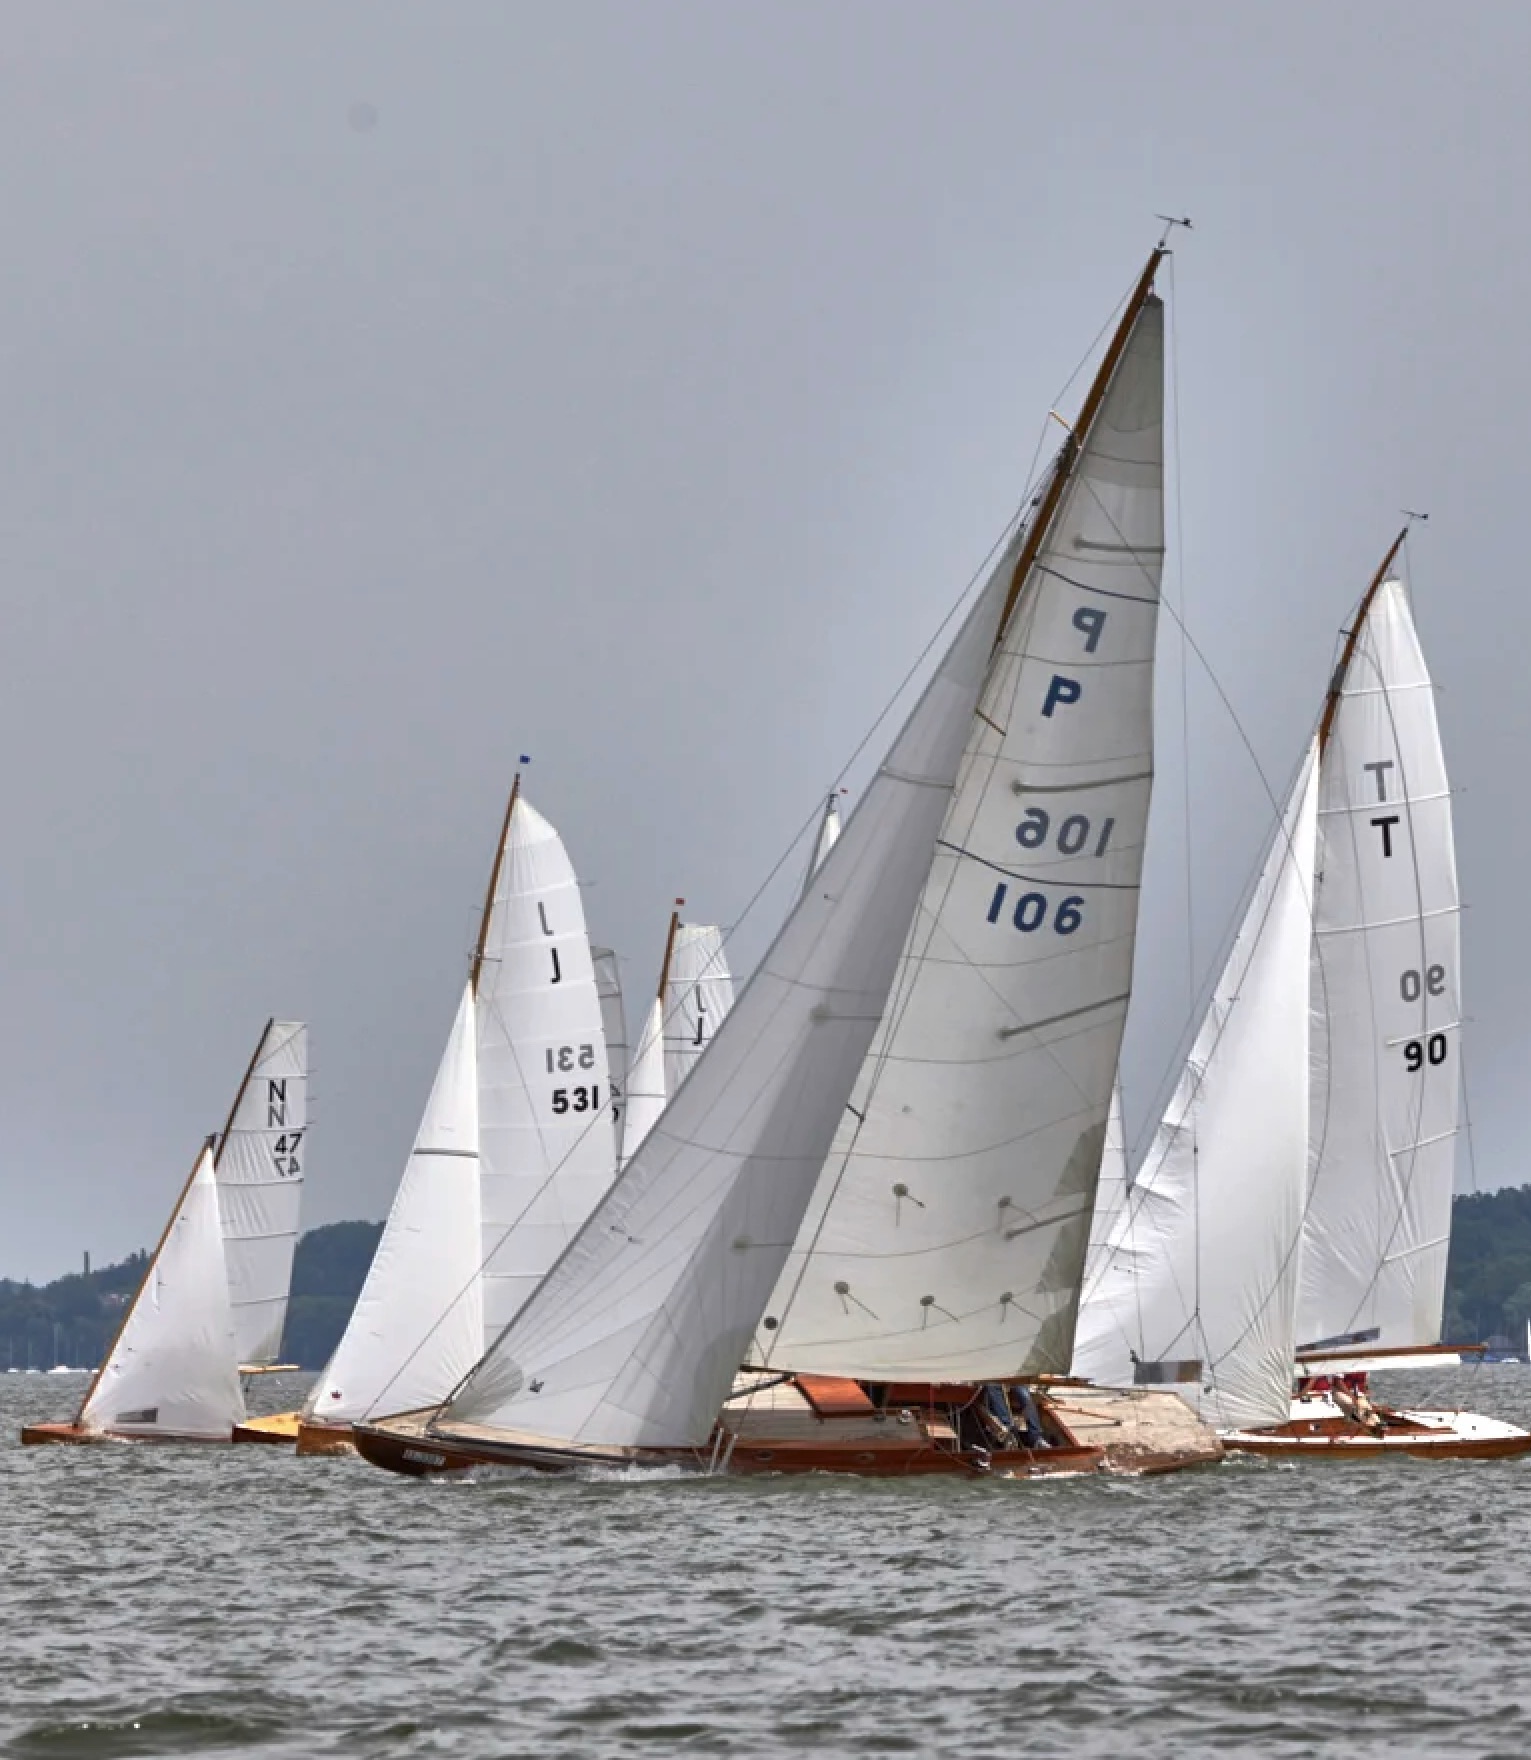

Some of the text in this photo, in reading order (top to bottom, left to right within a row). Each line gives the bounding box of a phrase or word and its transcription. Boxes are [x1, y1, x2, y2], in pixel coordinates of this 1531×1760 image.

[1041, 674, 1081, 717] P
[1363, 760, 1394, 802] T
[1370, 815, 1400, 858] T
[987, 882, 1085, 936] 106
[550, 948, 562, 984] J
[1403, 1033, 1447, 1073] 90
[268, 1078, 287, 1103] N
[551, 1085, 599, 1114] 531
[268, 1104, 285, 1128] N
[273, 1132, 303, 1154] 47
